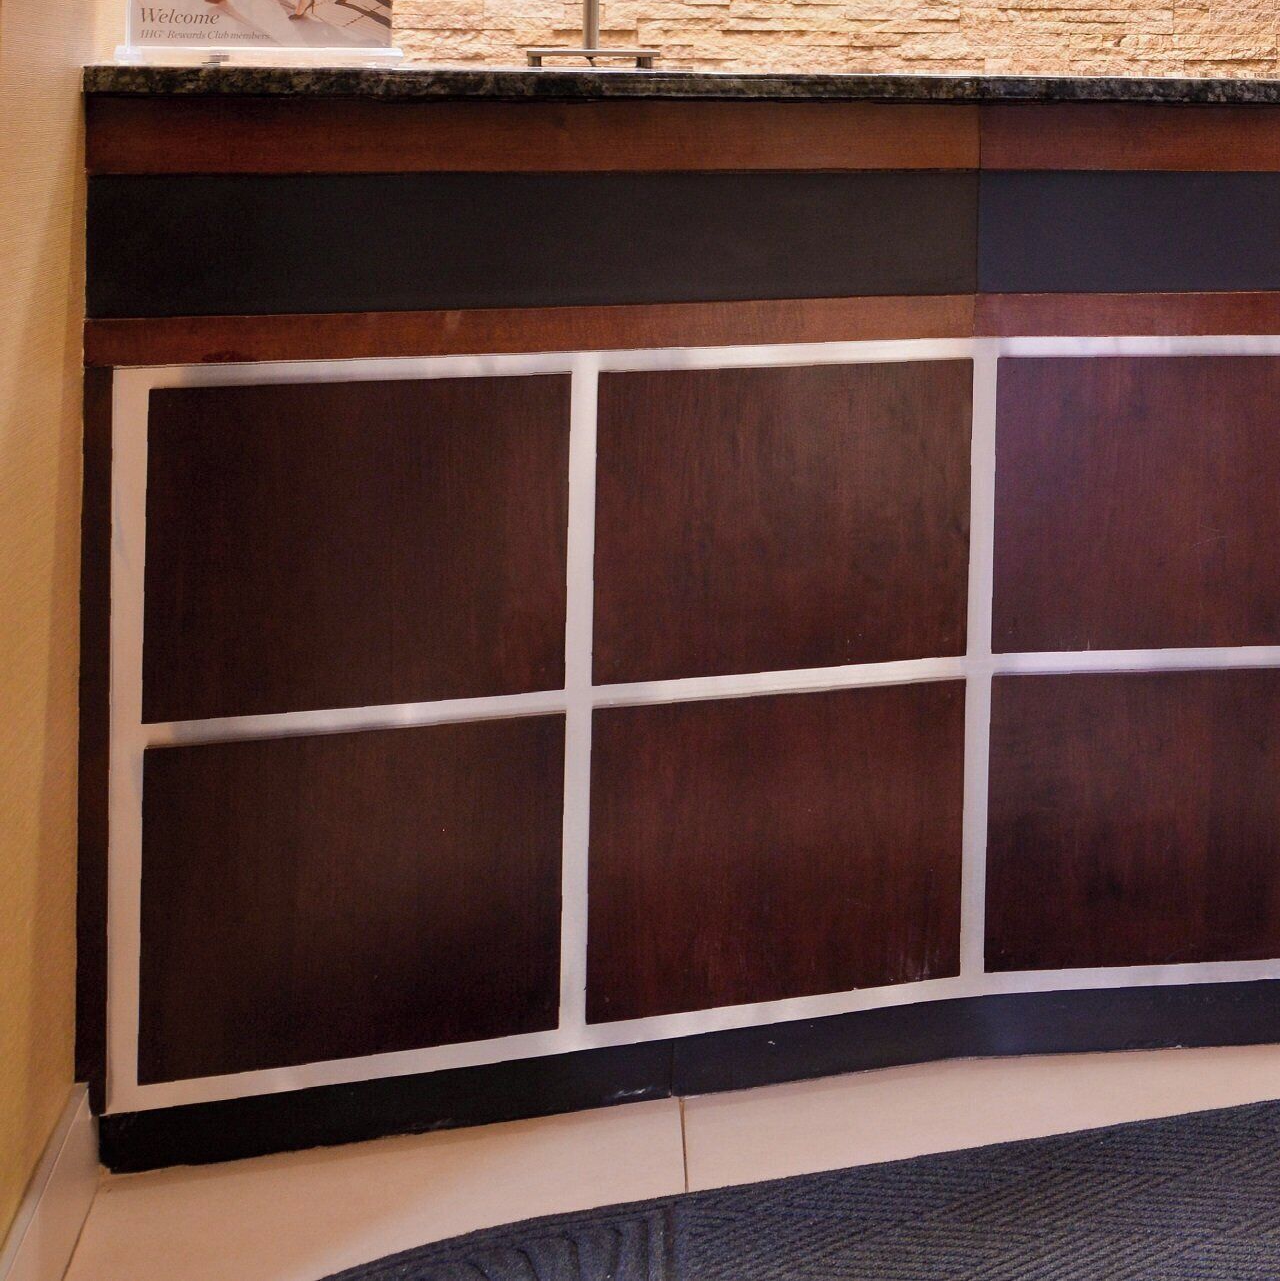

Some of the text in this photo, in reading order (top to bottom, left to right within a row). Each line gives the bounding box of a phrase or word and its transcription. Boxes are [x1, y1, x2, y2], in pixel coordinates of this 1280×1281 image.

[140, 8, 220, 25] Welcome
[167, 30, 206, 40] Rewards
[207, 30, 229, 40] Club
